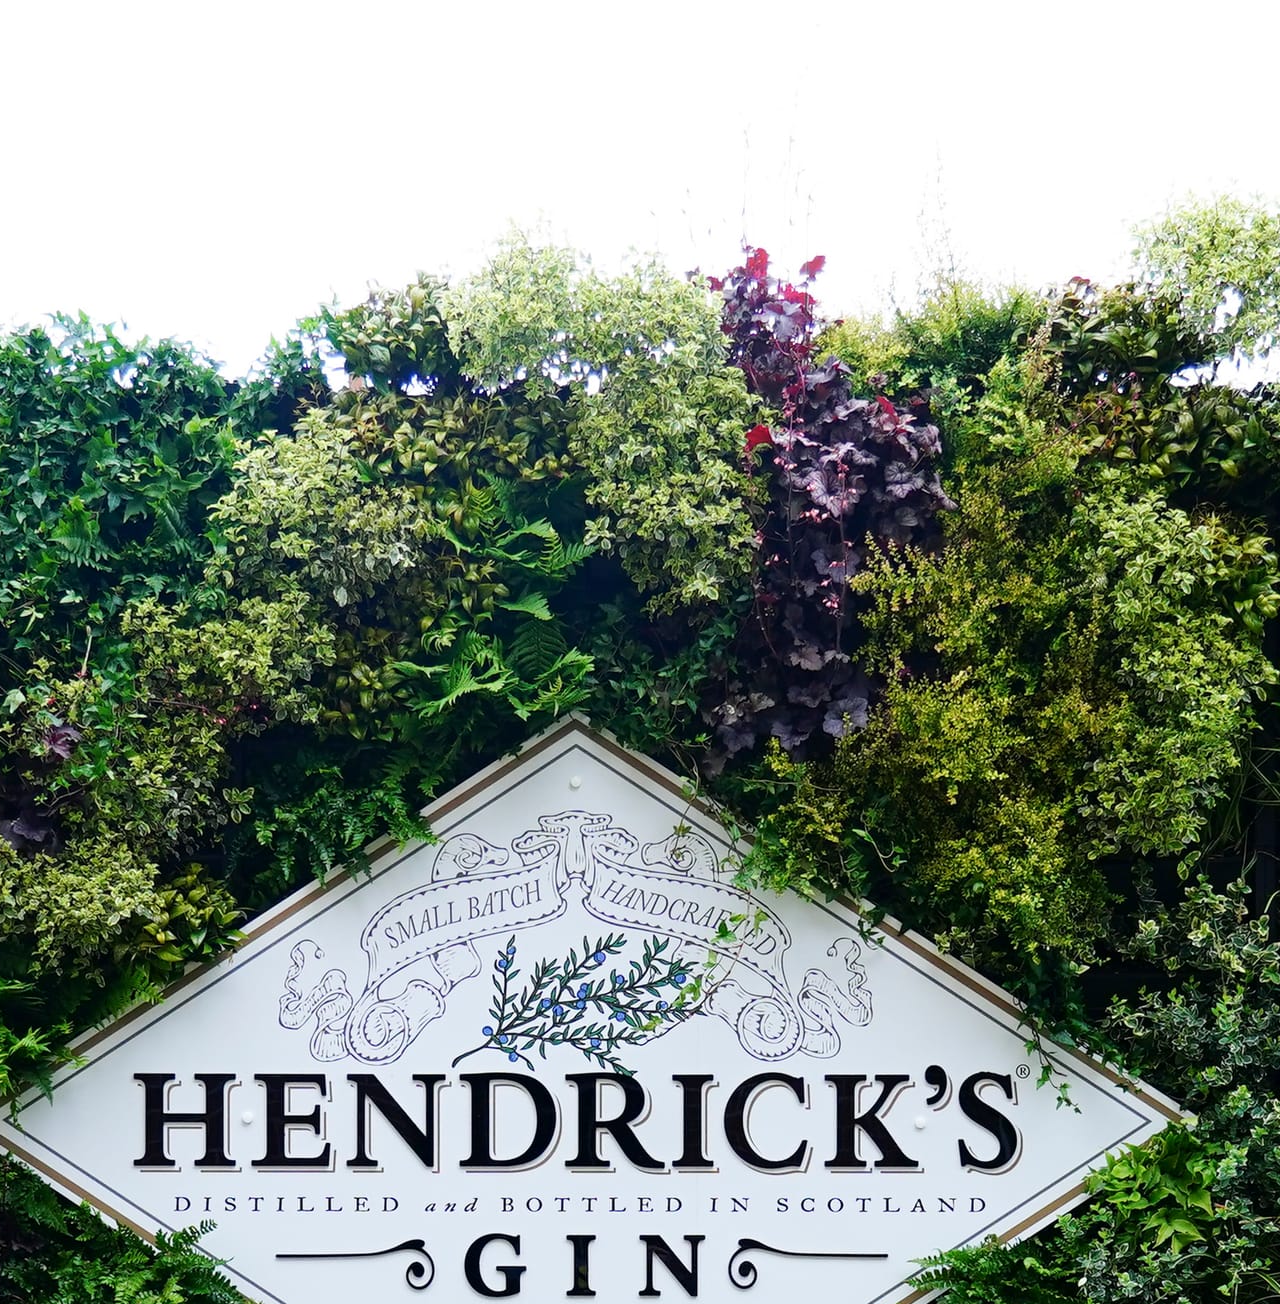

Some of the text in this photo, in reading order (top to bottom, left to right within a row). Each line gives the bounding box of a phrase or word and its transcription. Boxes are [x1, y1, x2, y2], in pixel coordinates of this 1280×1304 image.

[384, 879, 543, 949] SMALL BATCH
[174, 1196, 986, 1213] DISTILLED and BOTTLED IN SCOTLAND
[463, 1232, 707, 1299] GIN
